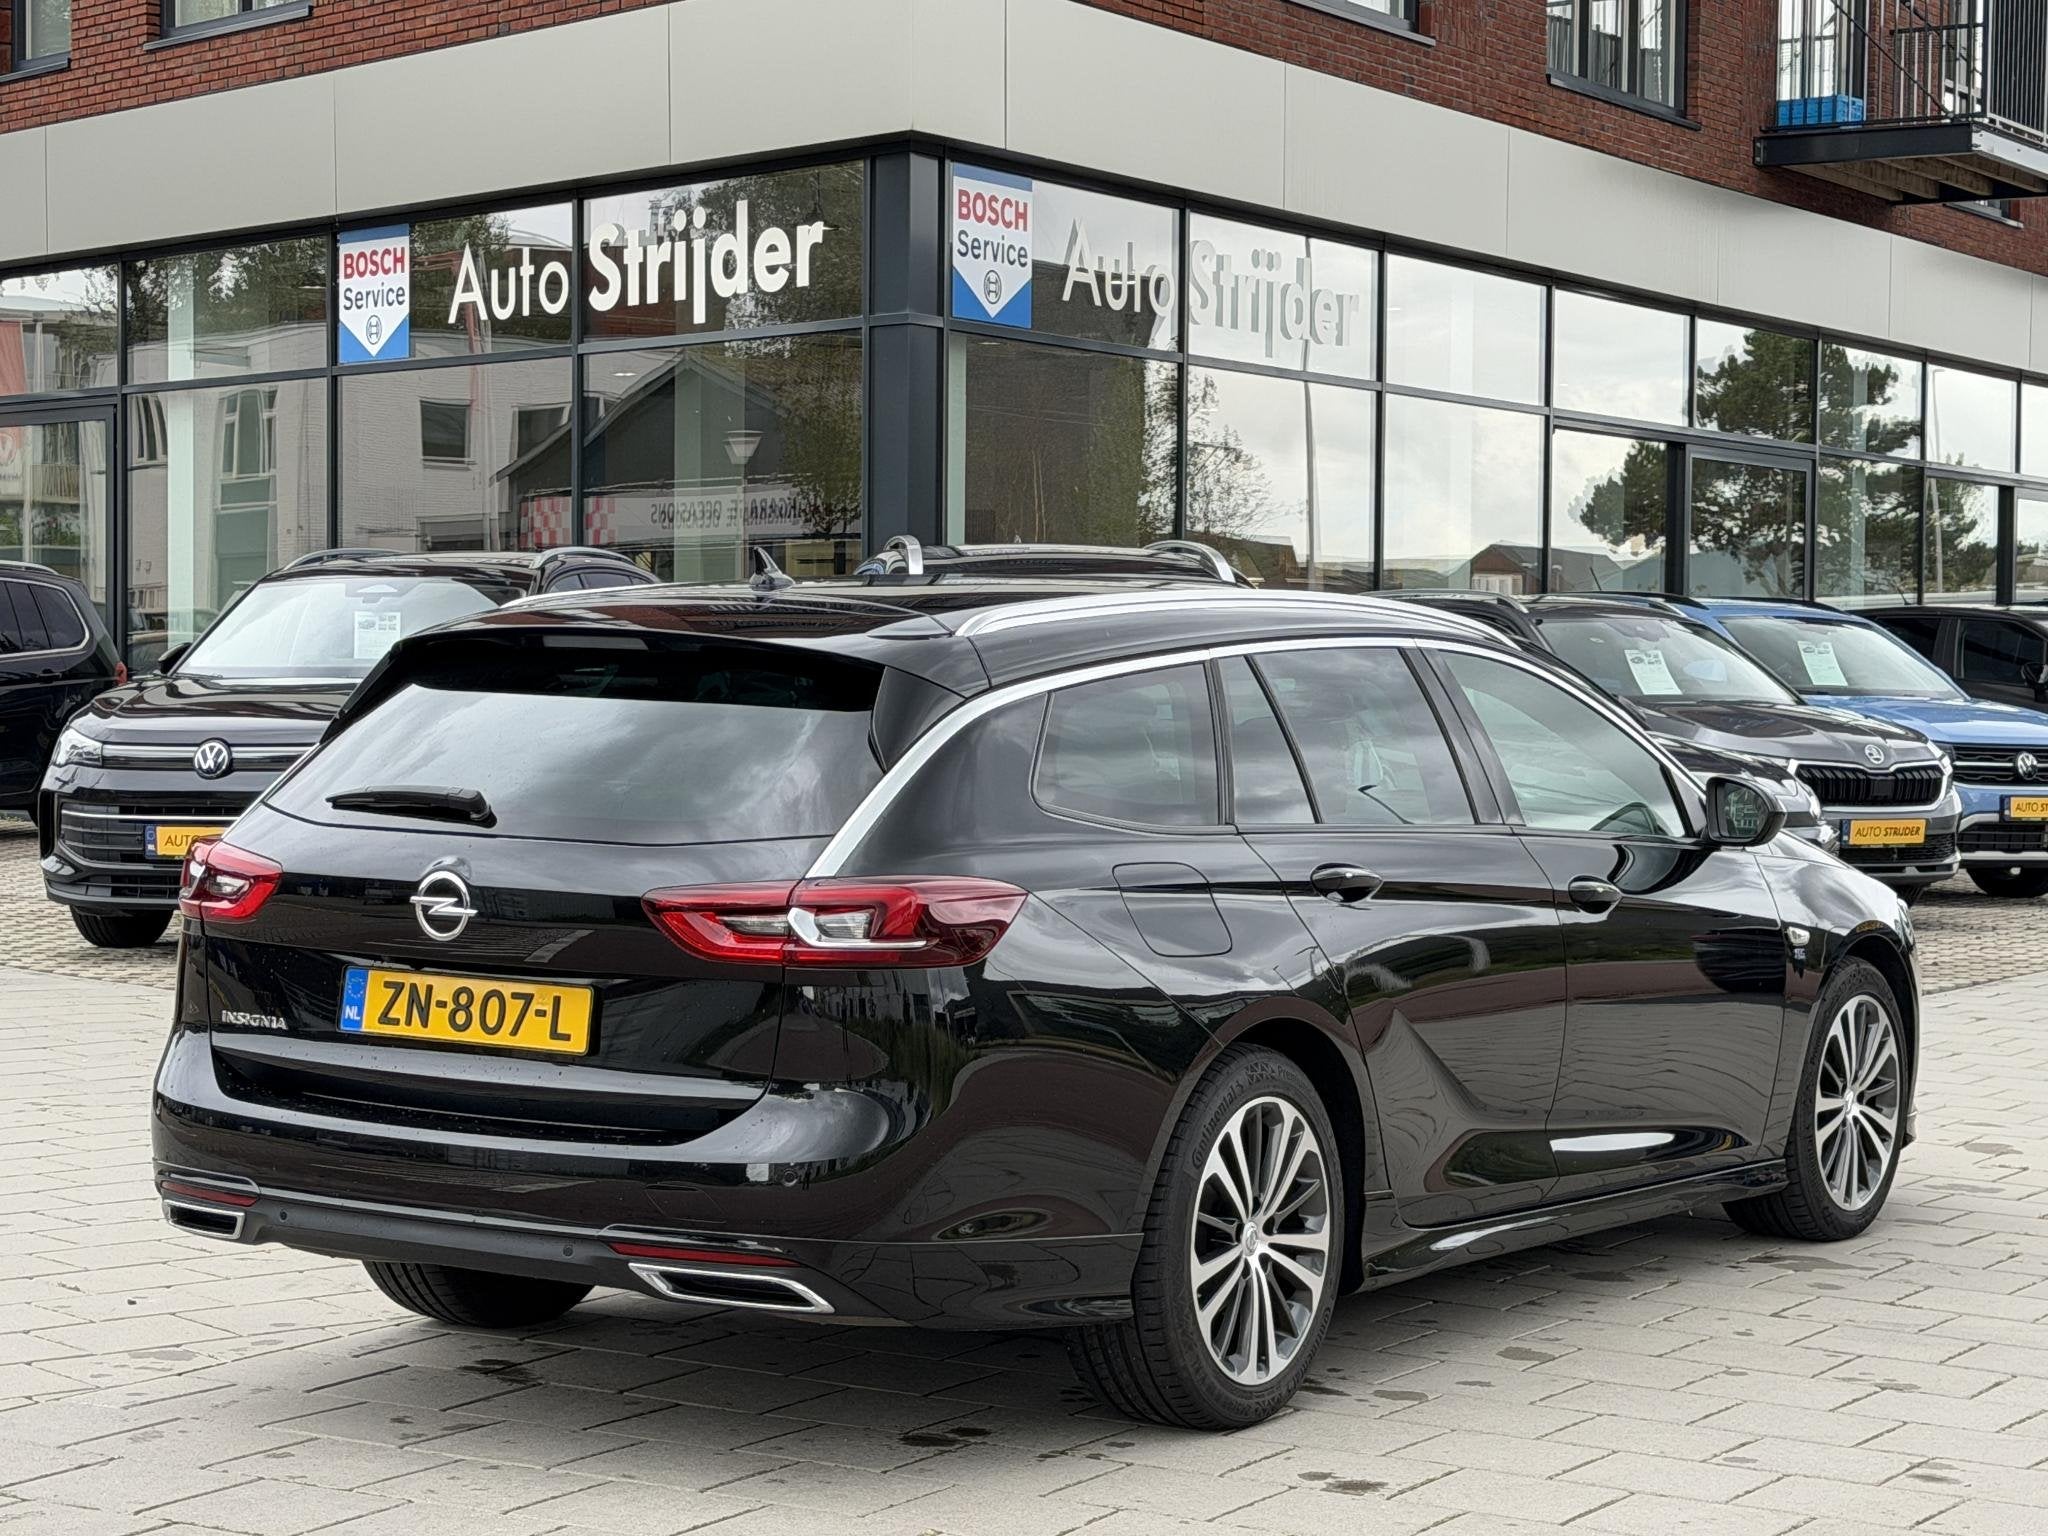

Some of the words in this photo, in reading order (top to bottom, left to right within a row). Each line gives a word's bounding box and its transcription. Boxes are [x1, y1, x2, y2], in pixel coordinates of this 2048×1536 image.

[958, 189, 1028, 232] BOSCH
[343, 247, 405, 279] BOSCH
[448, 241, 569, 324] Auto
[588, 200, 825, 324] Strijder
[957, 230, 1028, 267] Service
[343, 282, 405, 310] Service
[1062, 218, 1176, 316] Auto
[1190, 240, 1359, 358] Strijder
[2015, 802, 2039, 812] AUTO
[1855, 827, 1881, 837] AUTO
[222, 1010, 288, 1030] INSIGNIA
[345, 1005, 360, 1020] NL
[378, 980, 571, 1042] ZN-807-L
